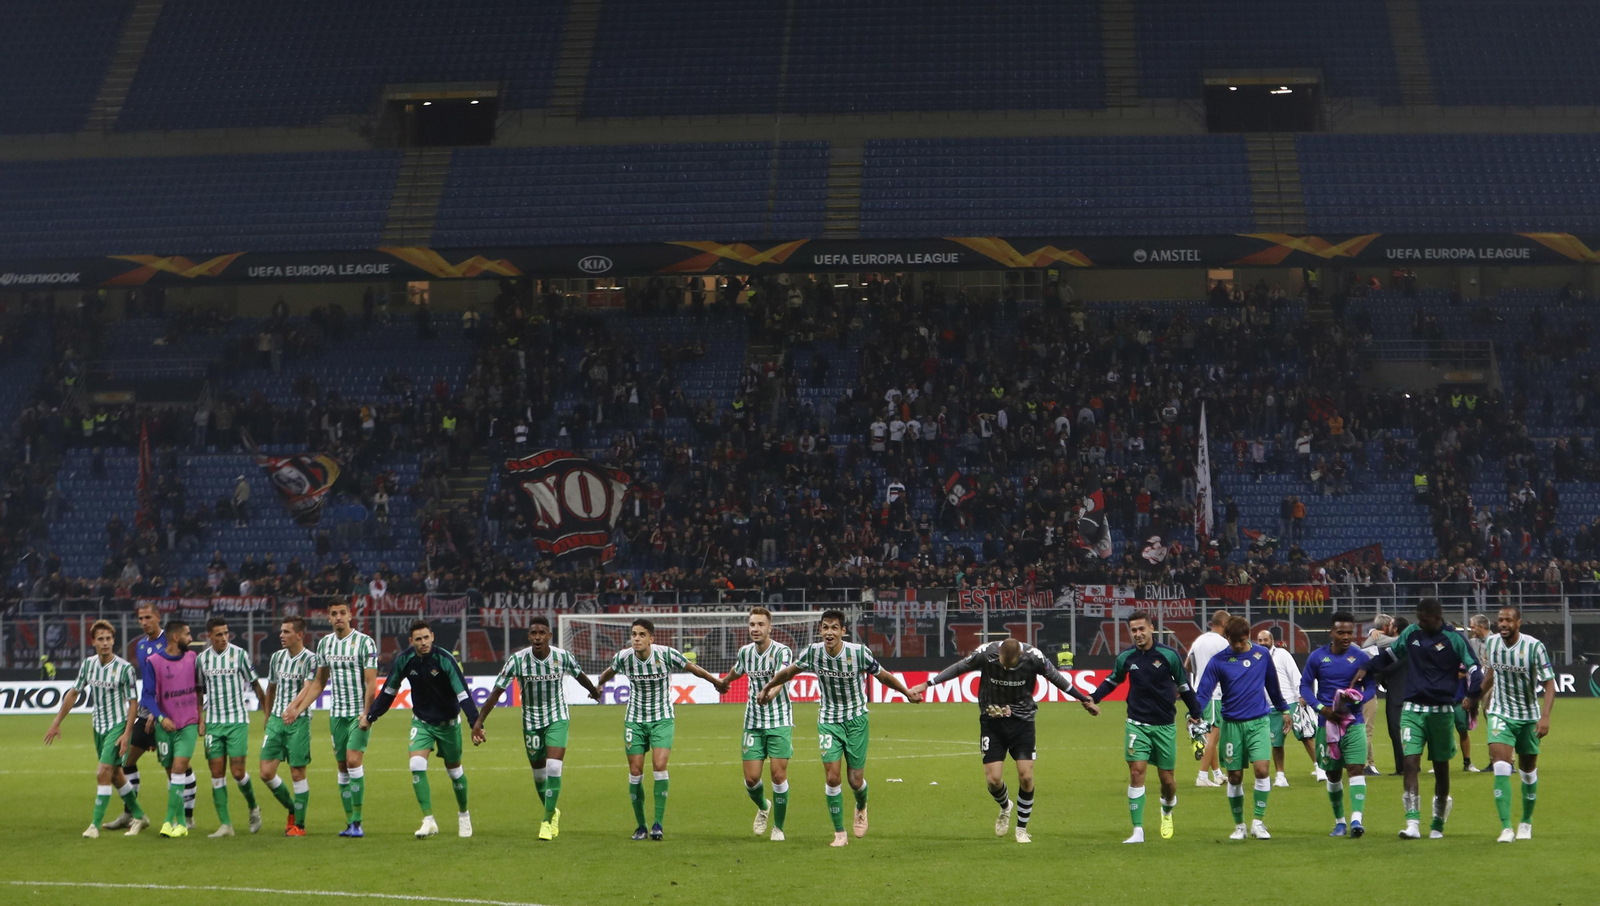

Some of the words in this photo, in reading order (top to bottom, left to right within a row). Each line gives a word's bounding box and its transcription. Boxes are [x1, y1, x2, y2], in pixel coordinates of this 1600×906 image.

[814, 254, 850, 265] UEFA
[853, 254, 904, 265] EUROPA
[907, 253, 959, 264] LEAGUE
[1150, 249, 1202, 262] AMSTEL
[1387, 248, 1421, 260] UEFA
[1424, 248, 1476, 260] EUROPA
[1478, 247, 1531, 259] LEAGUE
[248, 267, 283, 278] UEFA
[285, 265, 337, 277] EUROPA
[339, 264, 390, 275] LEAGUE
[582, 258, 609, 273] KIA
[959, 586, 1056, 613] ESTREMI
[1145, 584, 1187, 600] EMILIA
[484, 592, 570, 610] VECCHIA
[877, 600, 946, 619] ULTRAS
[1136, 601, 1196, 619] ROMAGNA
[817, 669, 856, 679] OTCDESKS
[1492, 716, 1507, 732] 12
[409, 727, 418, 741] 9
[526, 734, 541, 749] 20
[626, 727, 634, 742] 5
[743, 731, 756, 747] 16
[819, 734, 833, 749] 23
[1128, 732, 1138, 748] 7
[157, 740, 169, 756] 10
[1225, 742, 1234, 757] 8
